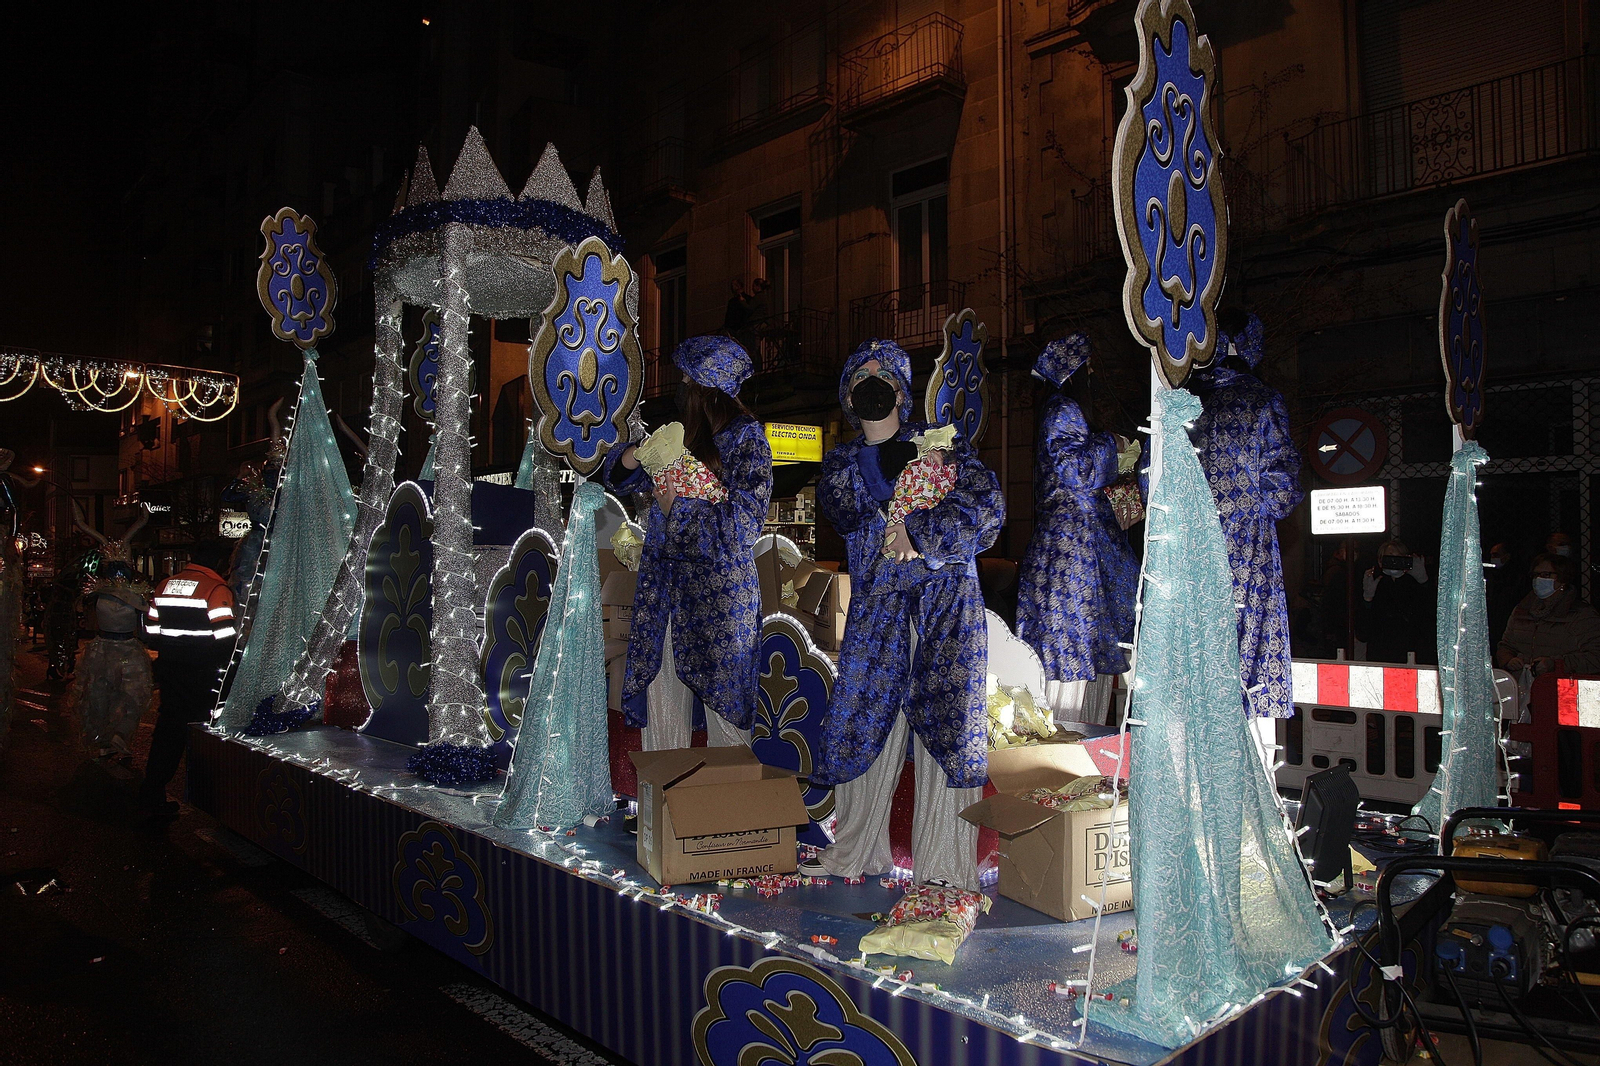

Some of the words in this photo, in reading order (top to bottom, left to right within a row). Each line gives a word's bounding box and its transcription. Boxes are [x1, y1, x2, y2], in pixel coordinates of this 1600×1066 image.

[772, 430, 797, 439] ELECTRO
[689, 869, 720, 881] MADE
[723, 868, 734, 877] IN
[736, 863, 774, 876] FRANCE
[1121, 899, 1132, 909] IN
